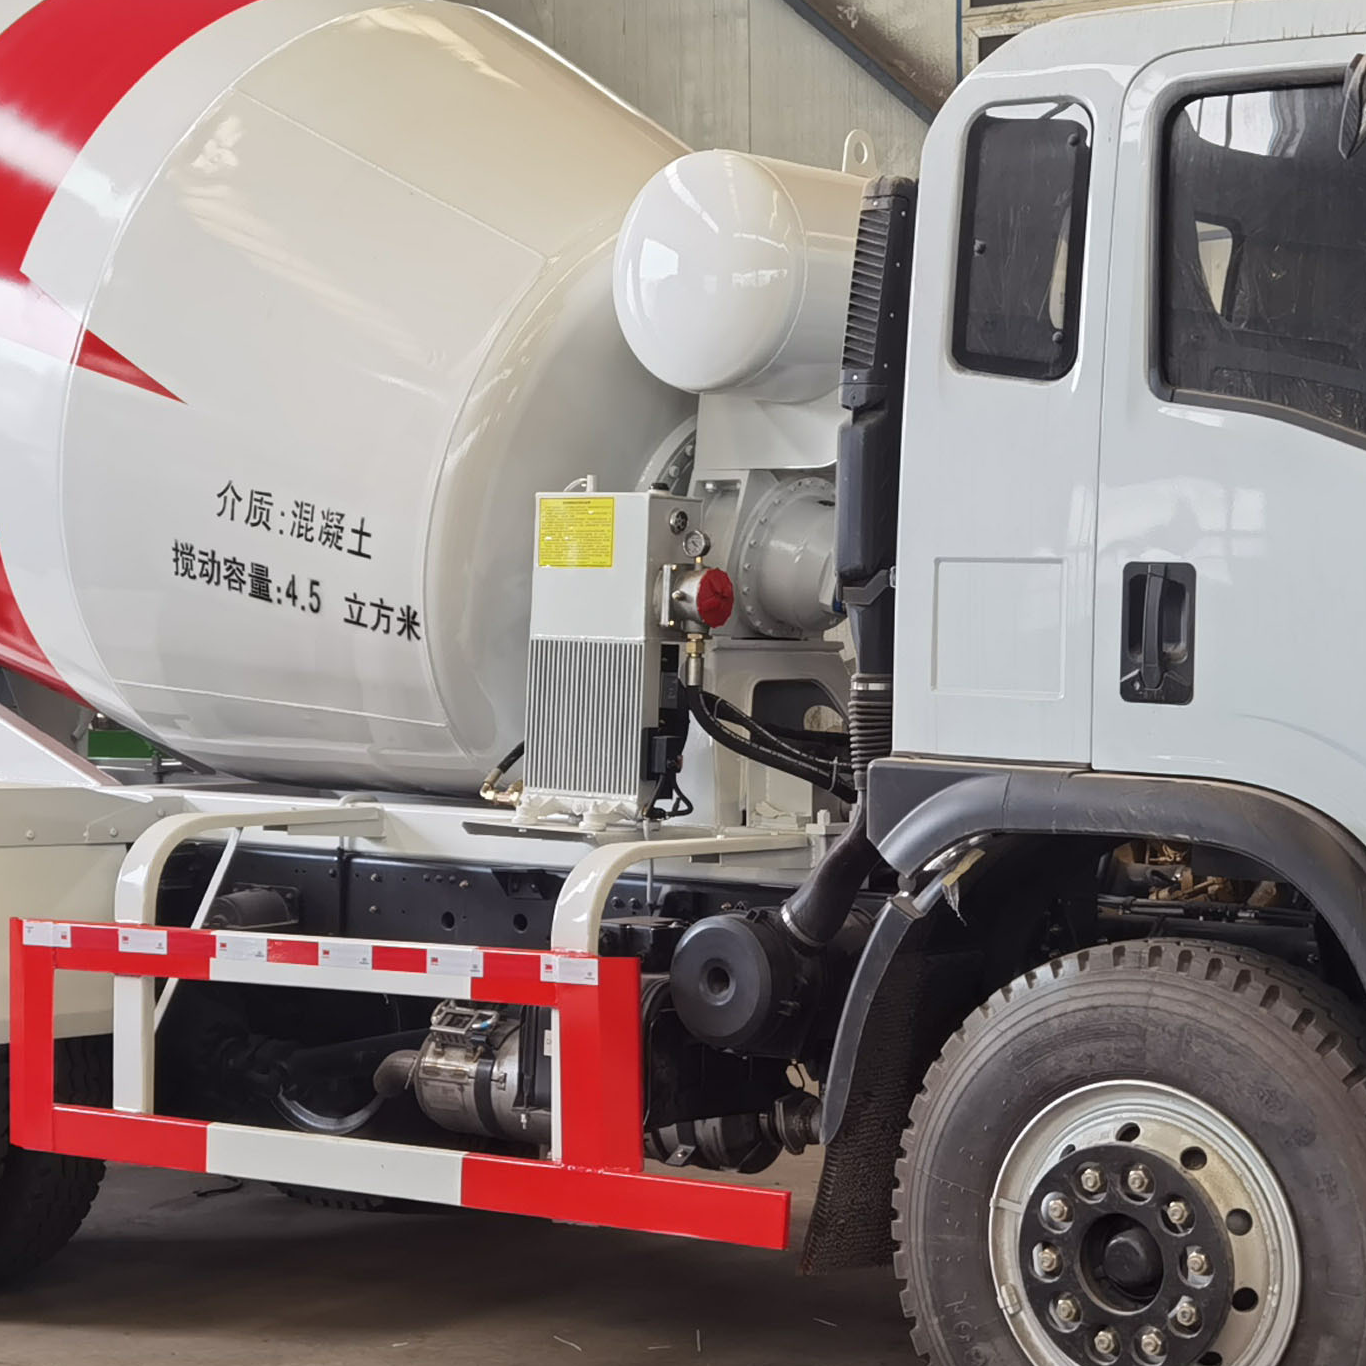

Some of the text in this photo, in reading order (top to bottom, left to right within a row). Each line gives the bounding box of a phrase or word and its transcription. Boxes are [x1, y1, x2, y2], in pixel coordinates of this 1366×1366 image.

[216, 480, 372, 560] 介质:混凝土
[343, 592, 421, 641] 立方米
